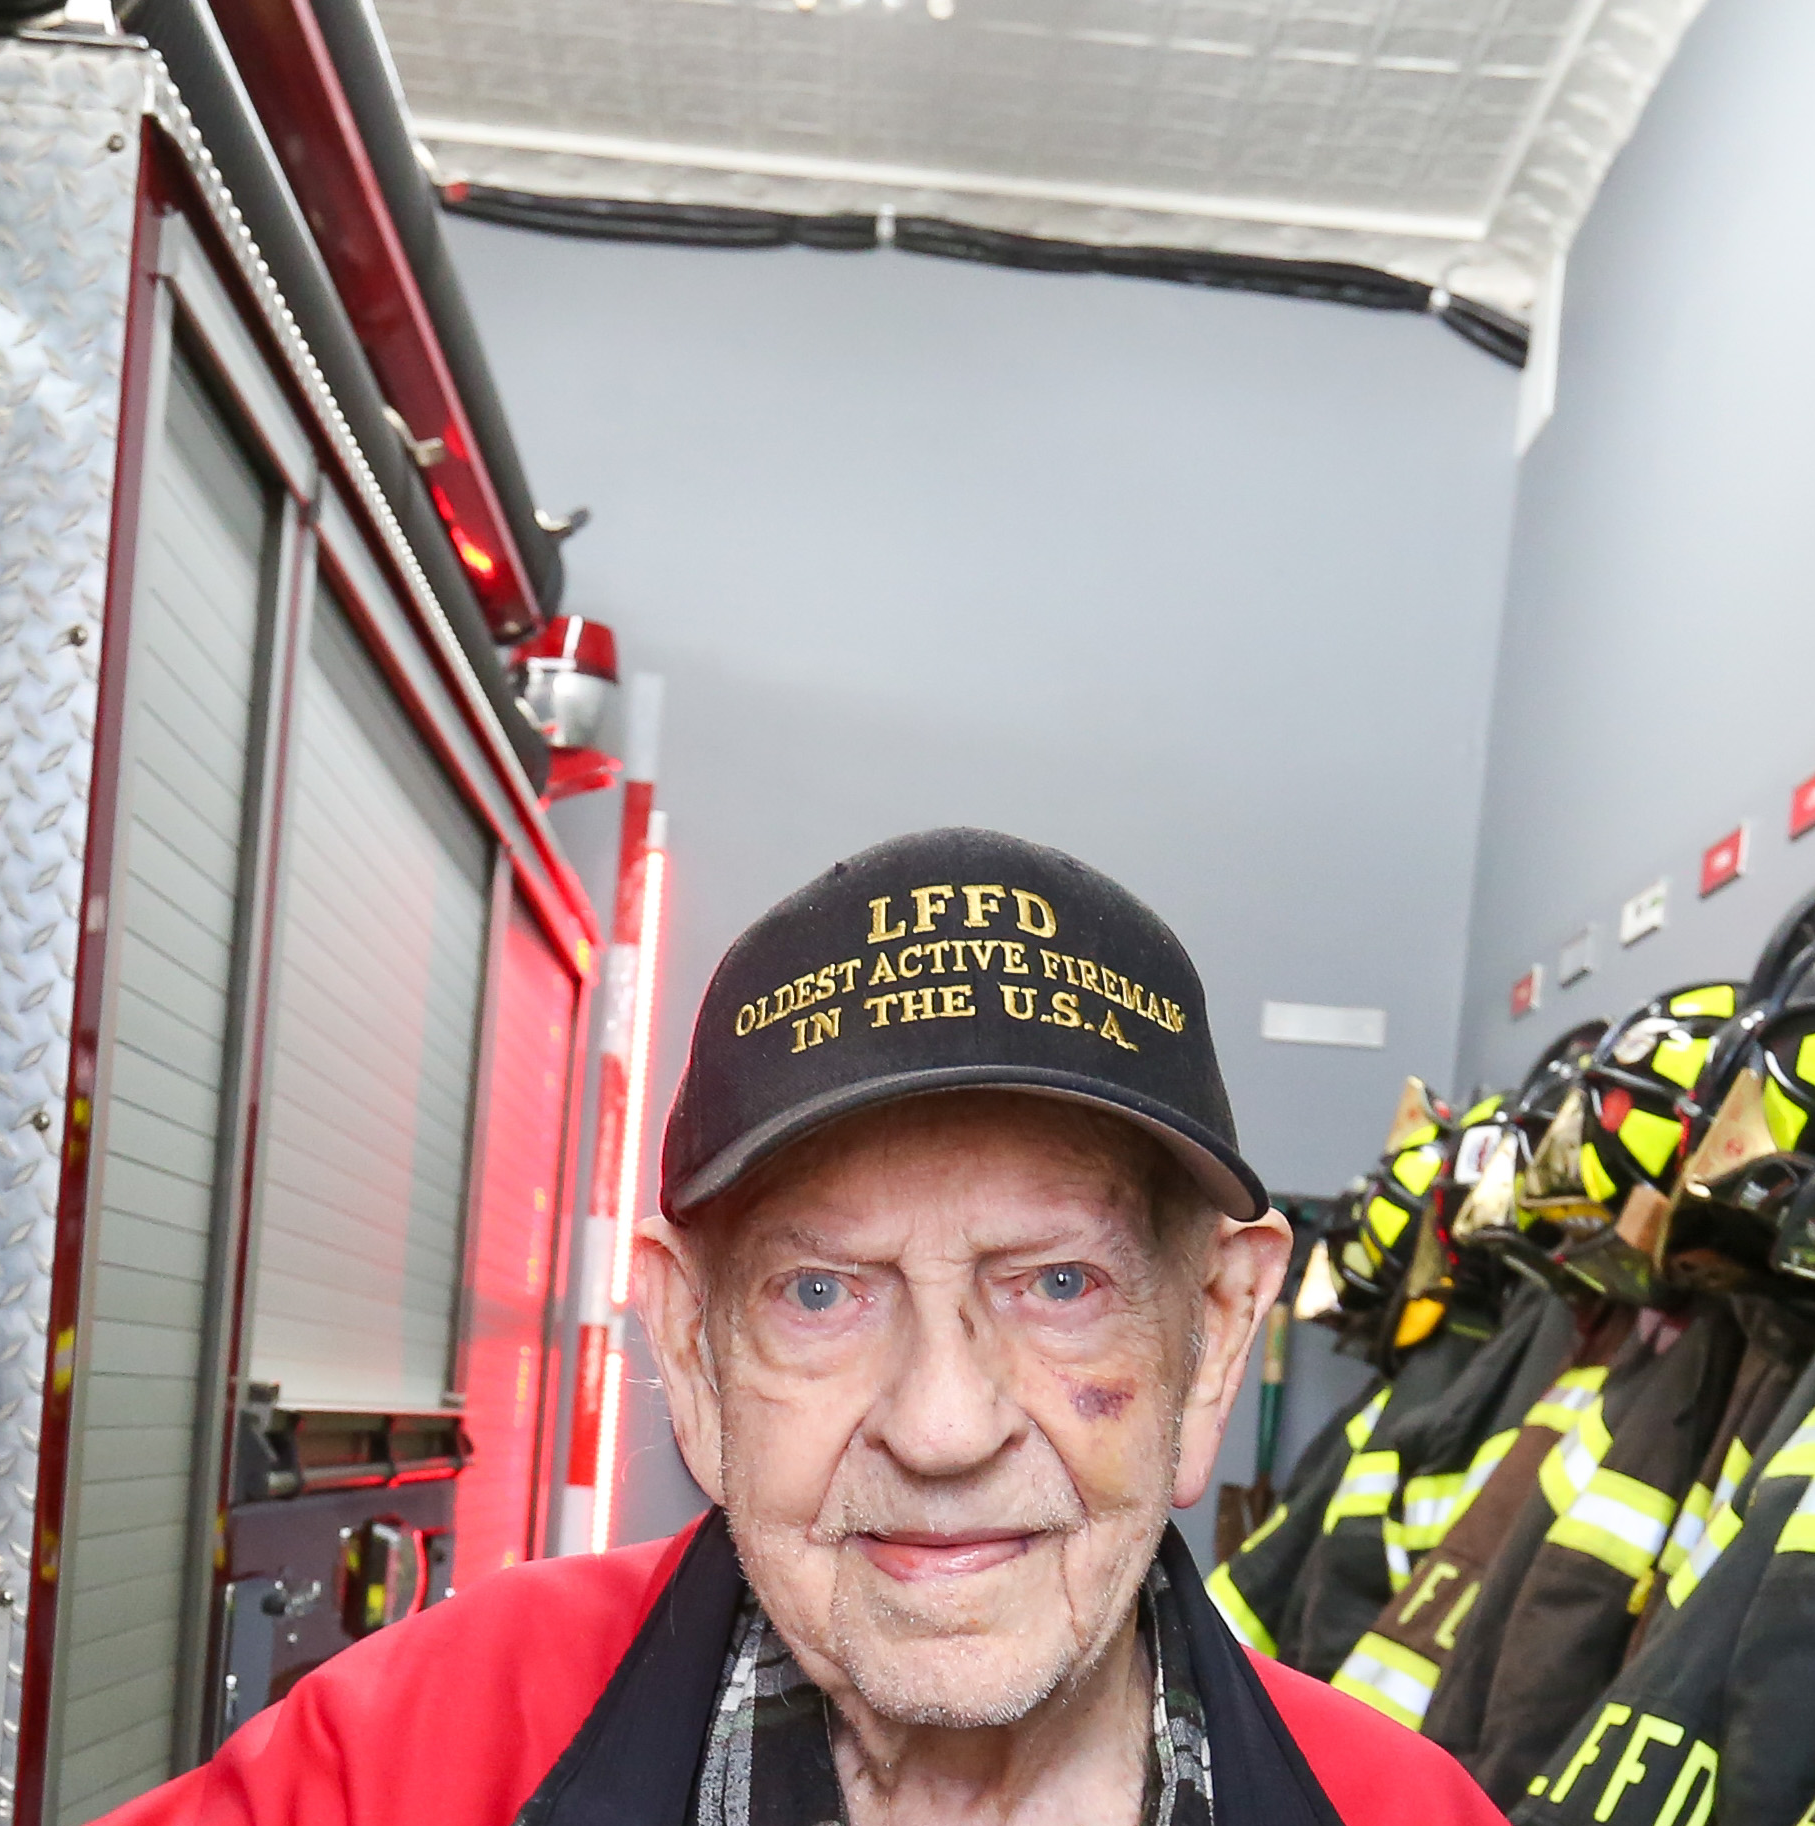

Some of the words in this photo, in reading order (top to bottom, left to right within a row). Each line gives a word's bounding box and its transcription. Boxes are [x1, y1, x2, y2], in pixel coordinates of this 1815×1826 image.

[866, 884, 1058, 944] LFFD
[734, 957, 863, 1037] OLDEST
[867, 940, 1030, 986] ACTIVE
[1039, 947, 1186, 1034] FIREMAN
[790, 1007, 842, 1054] IN
[863, 984, 977, 1028] THE
[998, 982, 1141, 1053] U.S.A.
